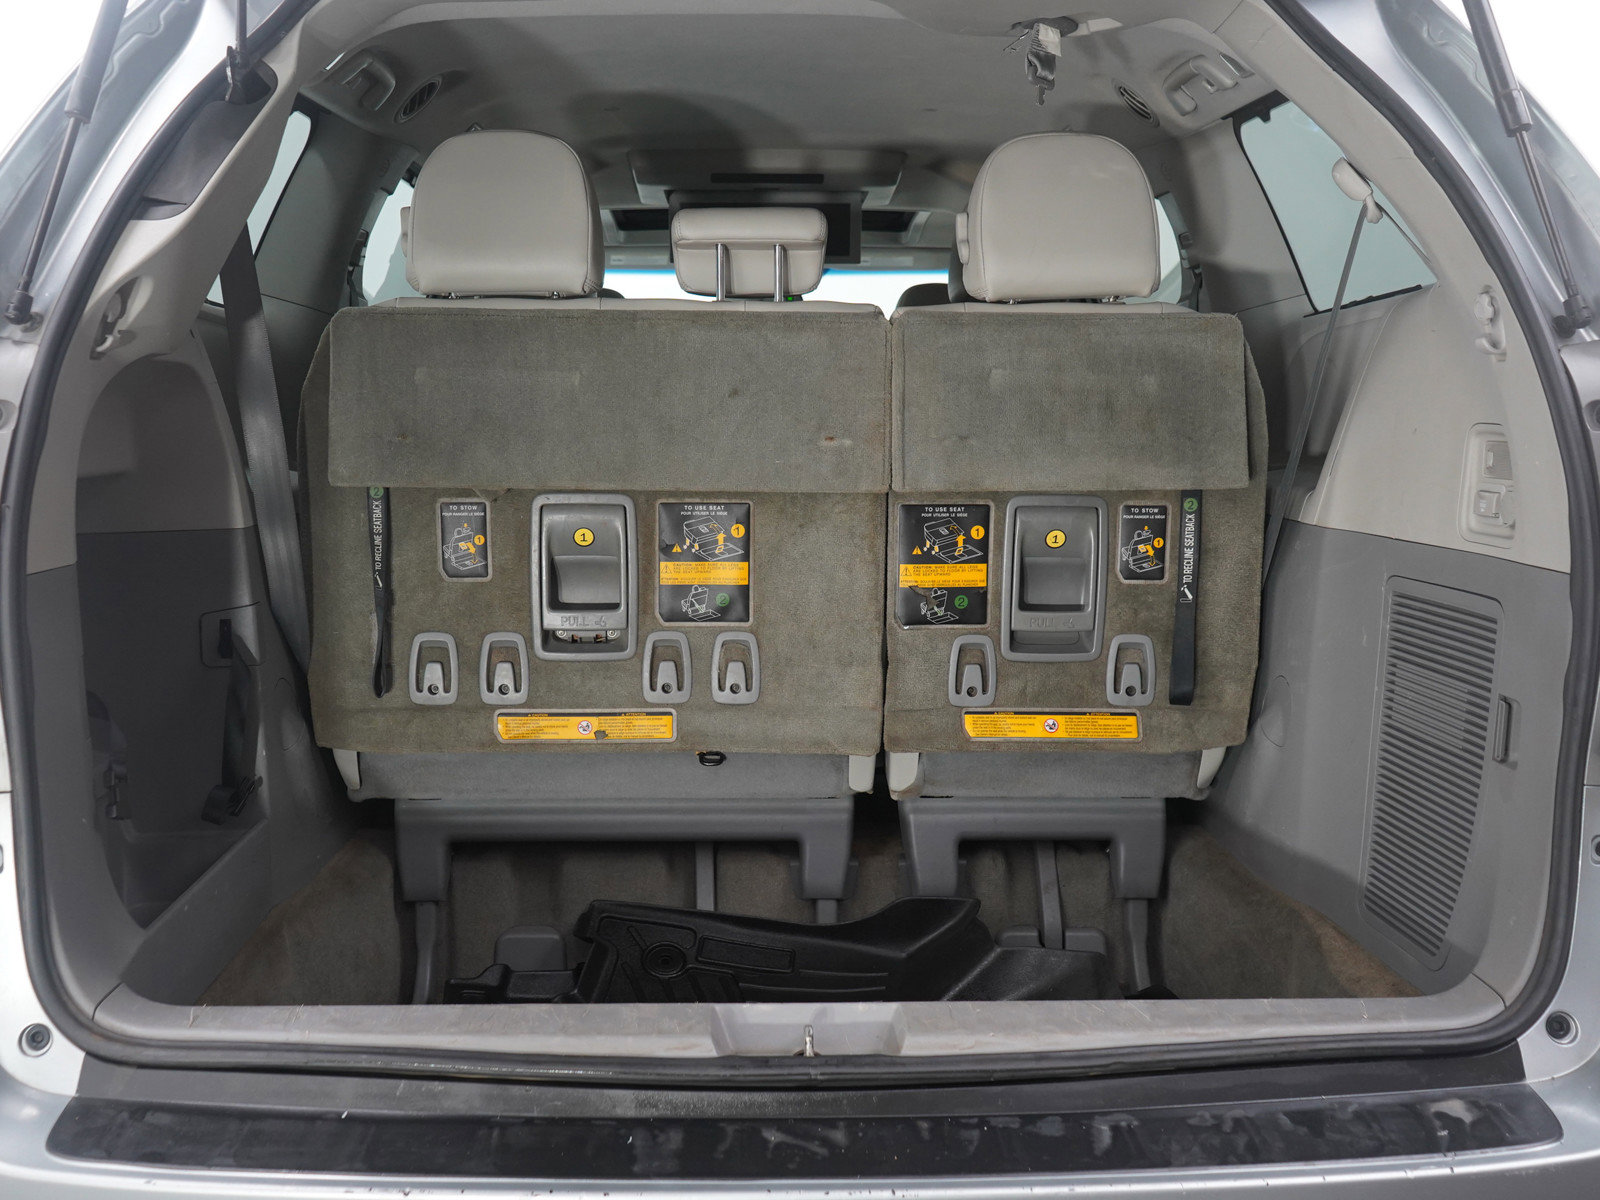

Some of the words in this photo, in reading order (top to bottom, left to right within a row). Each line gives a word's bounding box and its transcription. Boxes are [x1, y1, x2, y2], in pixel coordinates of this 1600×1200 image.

[372, 500, 383, 533] SEATBACK
[1185, 513, 1195, 546] SEATBACK
[580, 533, 588, 542] 1
[1052, 534, 1059, 544] 1
[373, 534, 382, 561] RECLINE
[374, 562, 382, 570] TO
[1183, 547, 1194, 574] RECLINE
[1183, 574, 1192, 583] TO
[958, 597, 965, 607] 2
[560, 616, 589, 627] PULL
[1029, 617, 1056, 628] PULL
